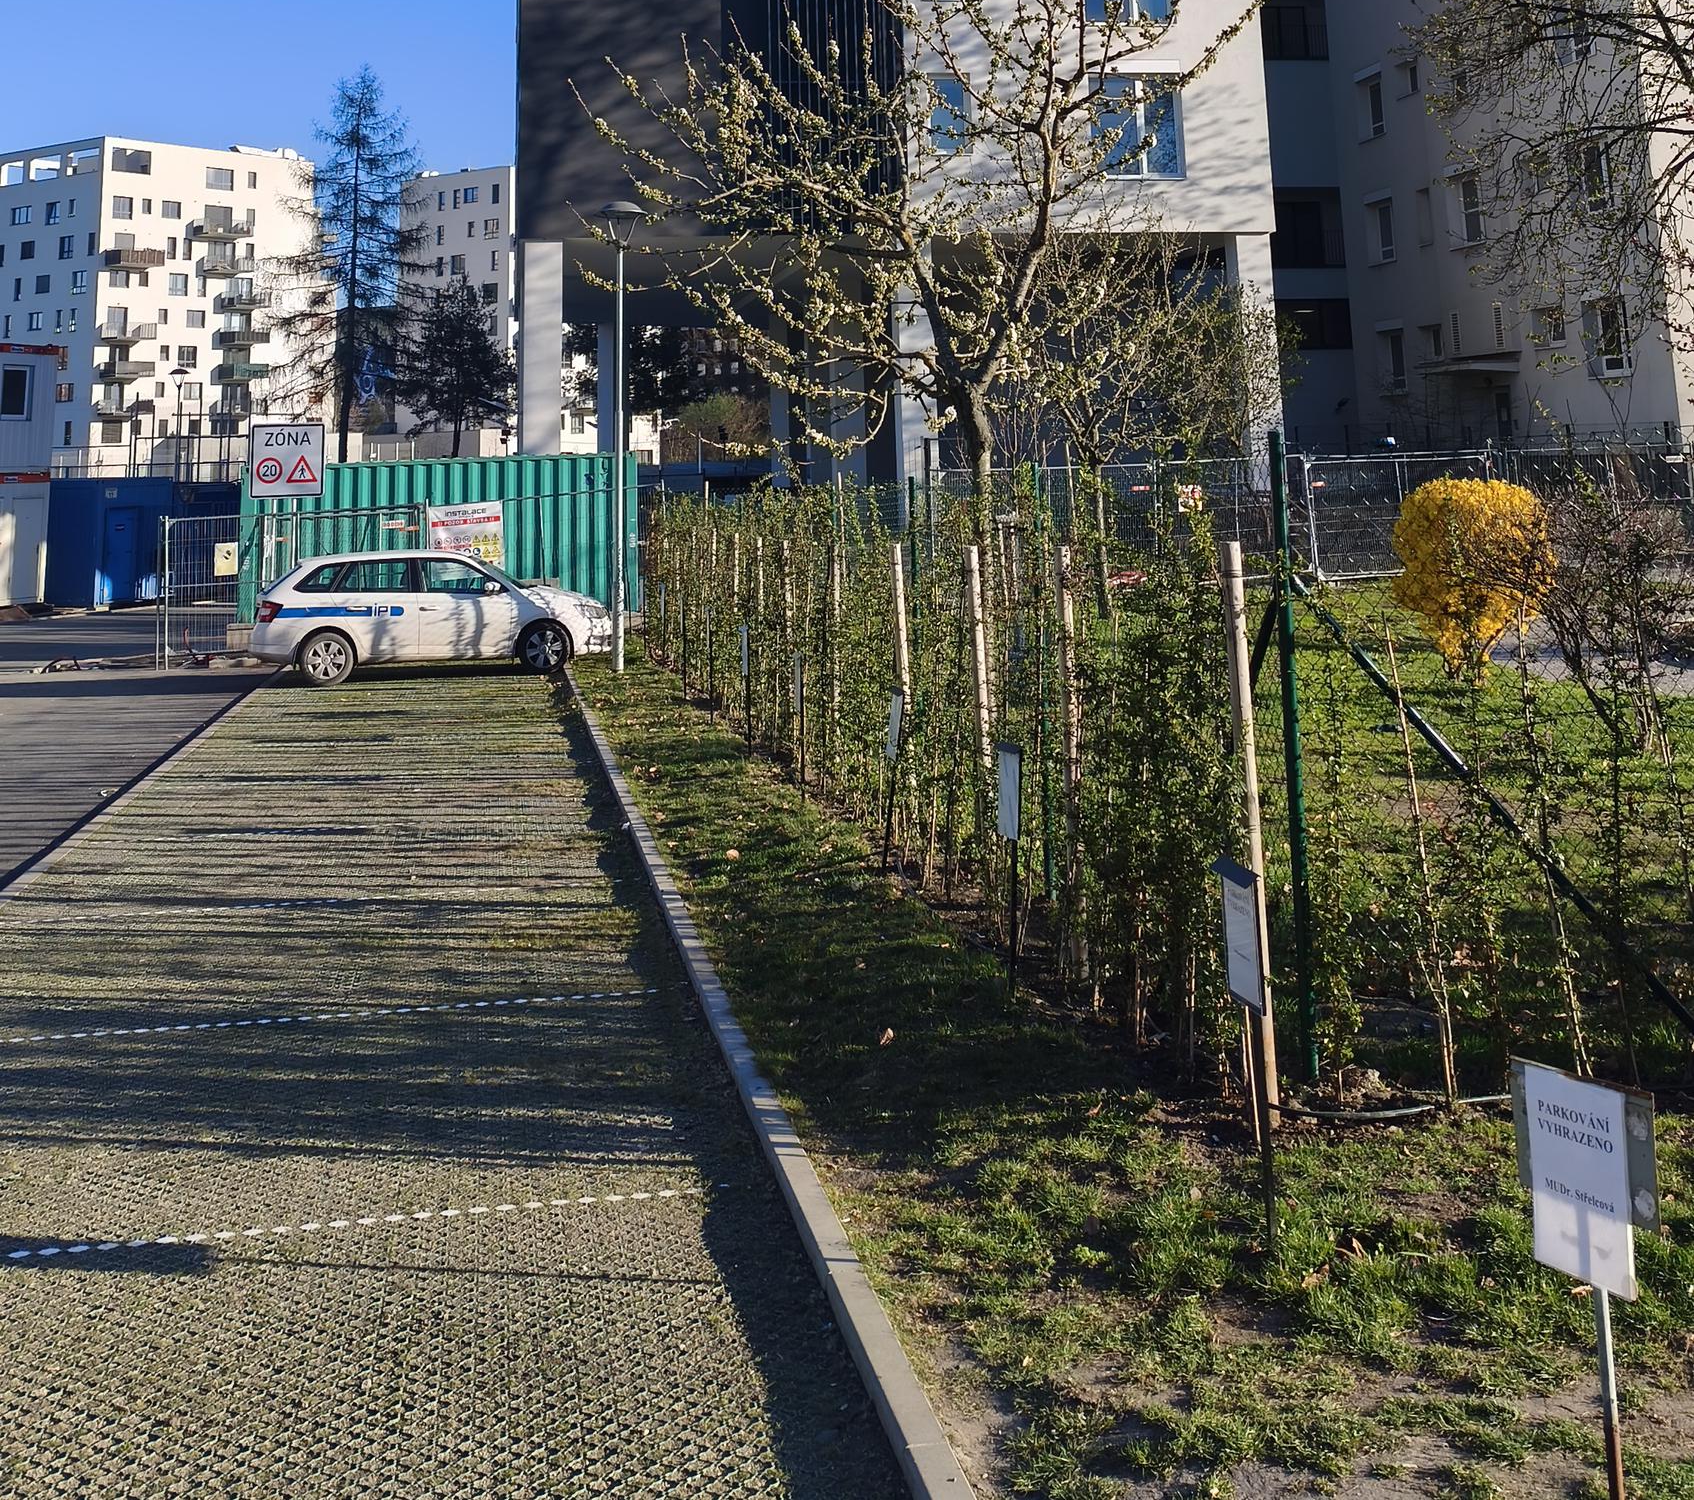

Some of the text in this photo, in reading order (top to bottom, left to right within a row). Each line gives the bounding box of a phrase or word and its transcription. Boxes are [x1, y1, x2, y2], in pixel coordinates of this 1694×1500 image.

[264, 428, 311, 446] ZÓNA
[262, 465, 277, 477] 20
[1538, 1100, 1610, 1134] PARKOVÁNÍ
[1538, 1118, 1614, 1154] VYHRAZENO
[1545, 1177, 1615, 1213] MUDr. Střelcová
